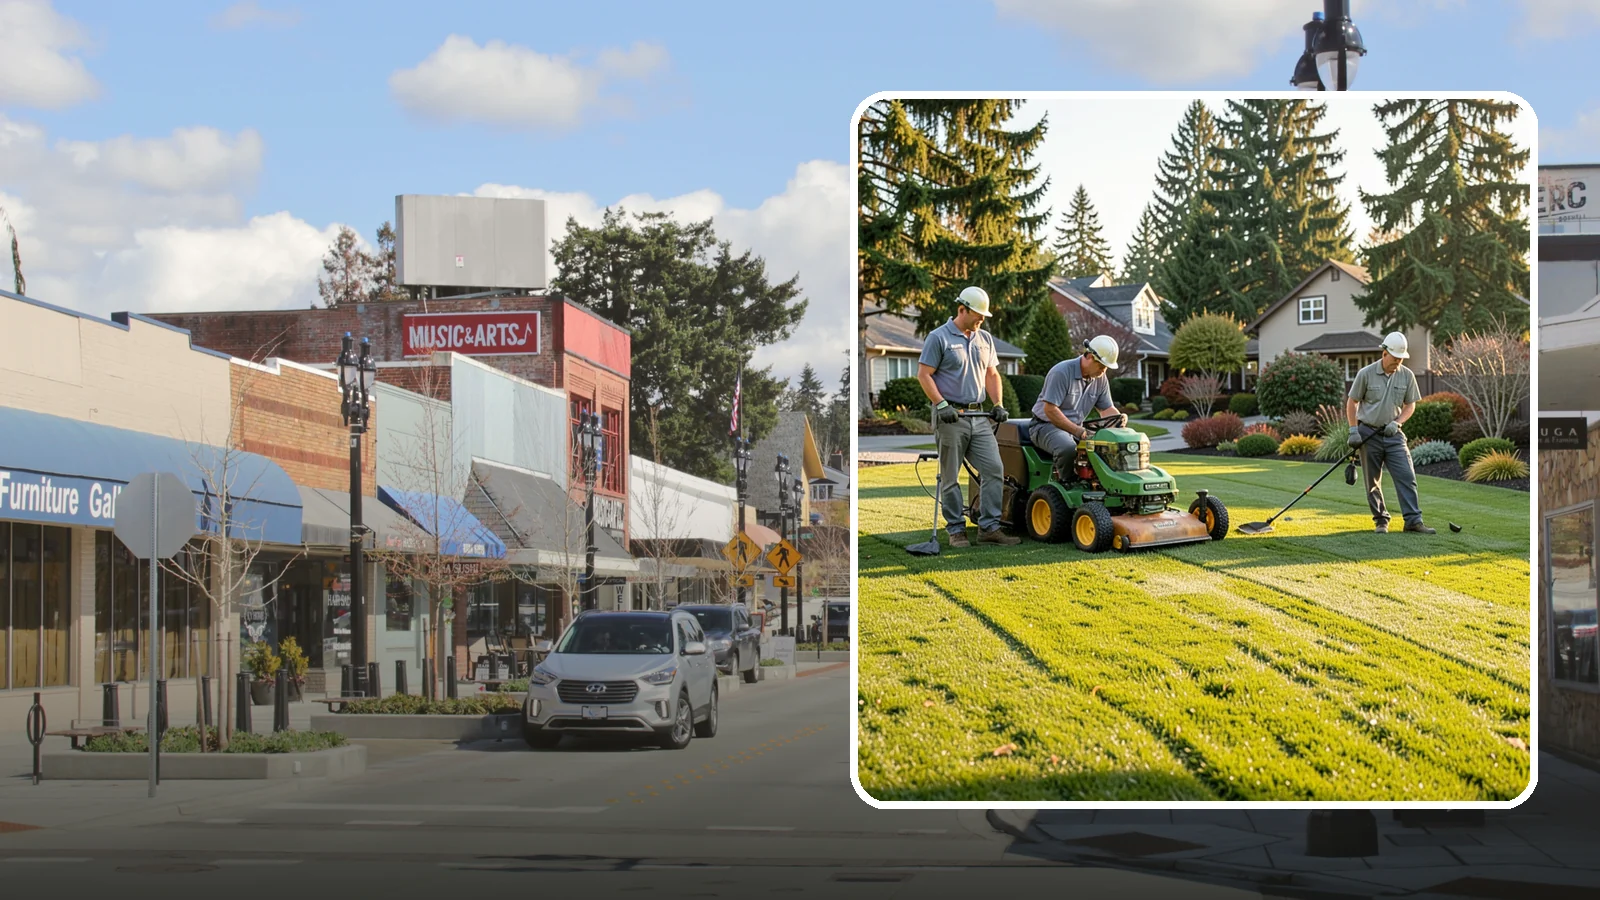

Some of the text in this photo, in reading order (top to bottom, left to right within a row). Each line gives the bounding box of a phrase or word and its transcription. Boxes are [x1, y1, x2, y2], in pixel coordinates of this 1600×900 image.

[408, 323, 519, 348] MUSIC&ARTS
[0, 471, 122, 519] Furniture Gal
